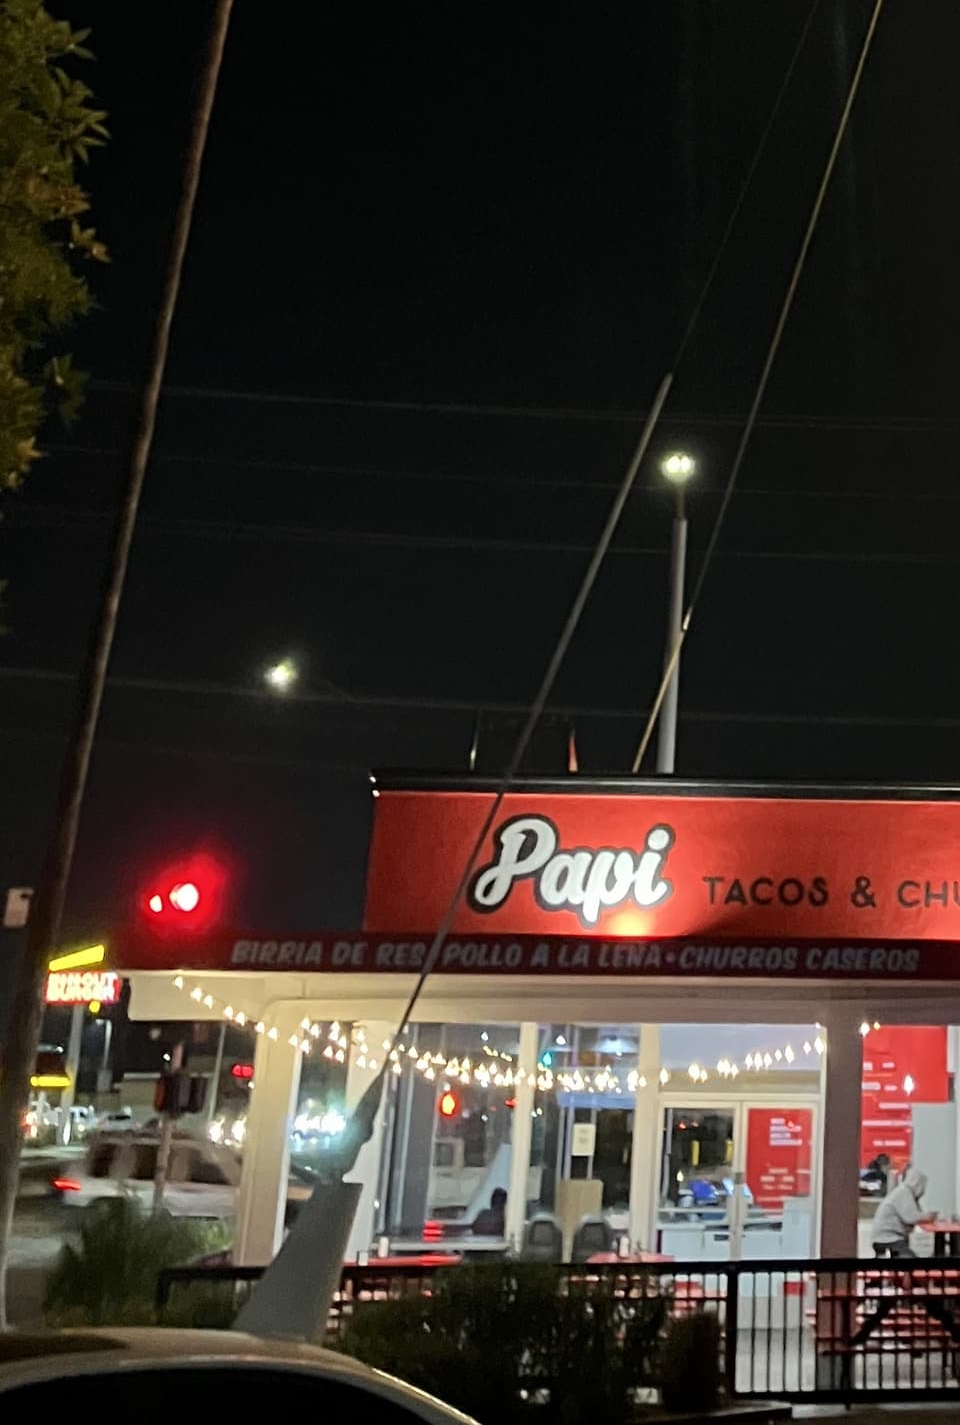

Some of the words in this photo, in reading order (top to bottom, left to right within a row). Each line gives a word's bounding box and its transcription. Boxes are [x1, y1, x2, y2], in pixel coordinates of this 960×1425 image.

[470, 816, 673, 926] Papi
[703, 876, 828, 907] TACOS
[851, 877, 876, 908] &
[231, 940, 321, 964] BIRRIA
[331, 941, 367, 964] DE
[376, 943, 425, 966] RES
[442, 943, 522, 967] POLLO
[530, 944, 549, 966] A
[558, 944, 590, 967] LA
[680, 946, 798, 970] CHURROS
[805, 947, 920, 972] CASEROS
